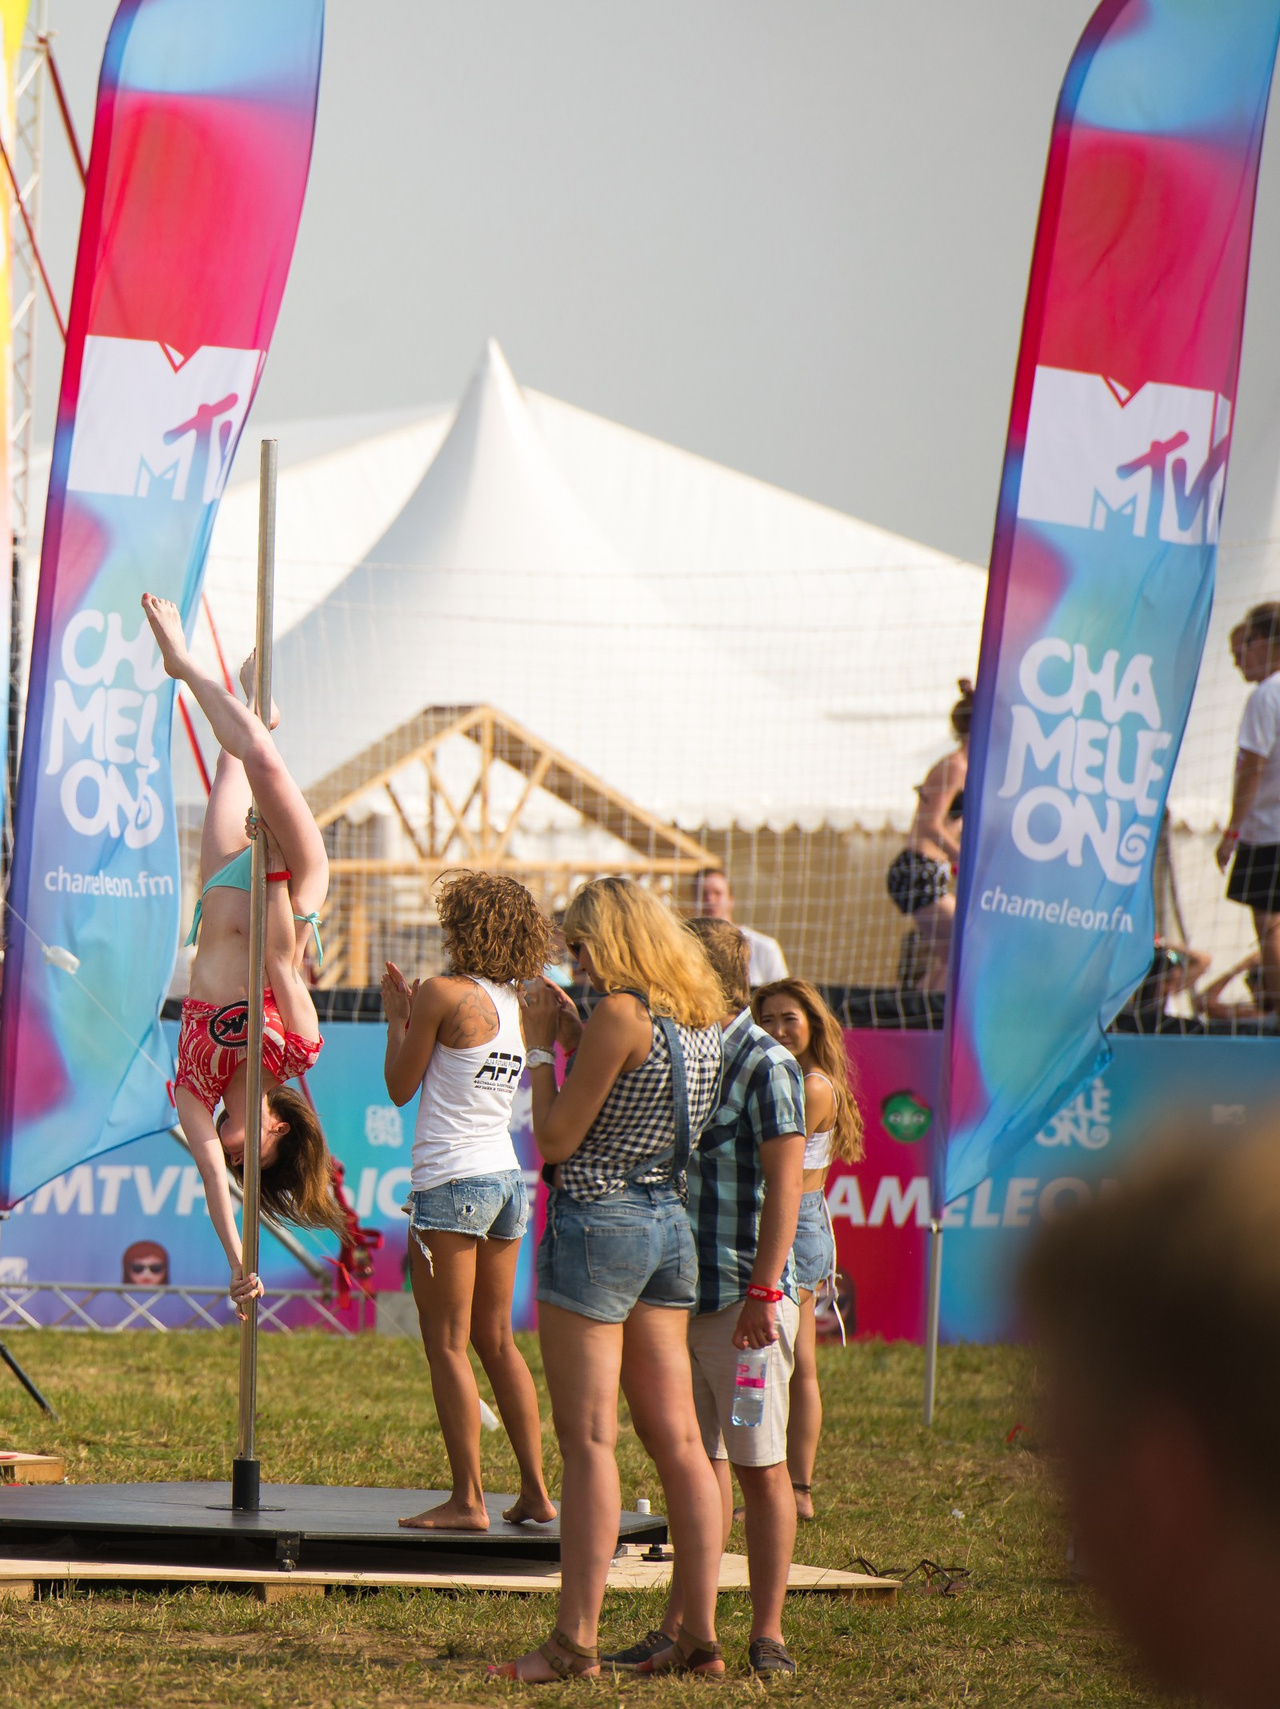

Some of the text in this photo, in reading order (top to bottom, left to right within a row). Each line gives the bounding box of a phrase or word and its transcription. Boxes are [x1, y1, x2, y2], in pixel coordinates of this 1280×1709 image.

[1019, 637, 1162, 731] CHA
[997, 703, 1173, 818] MELE
[1011, 784, 1151, 886] ON
[474, 1051, 523, 1083] AFP
